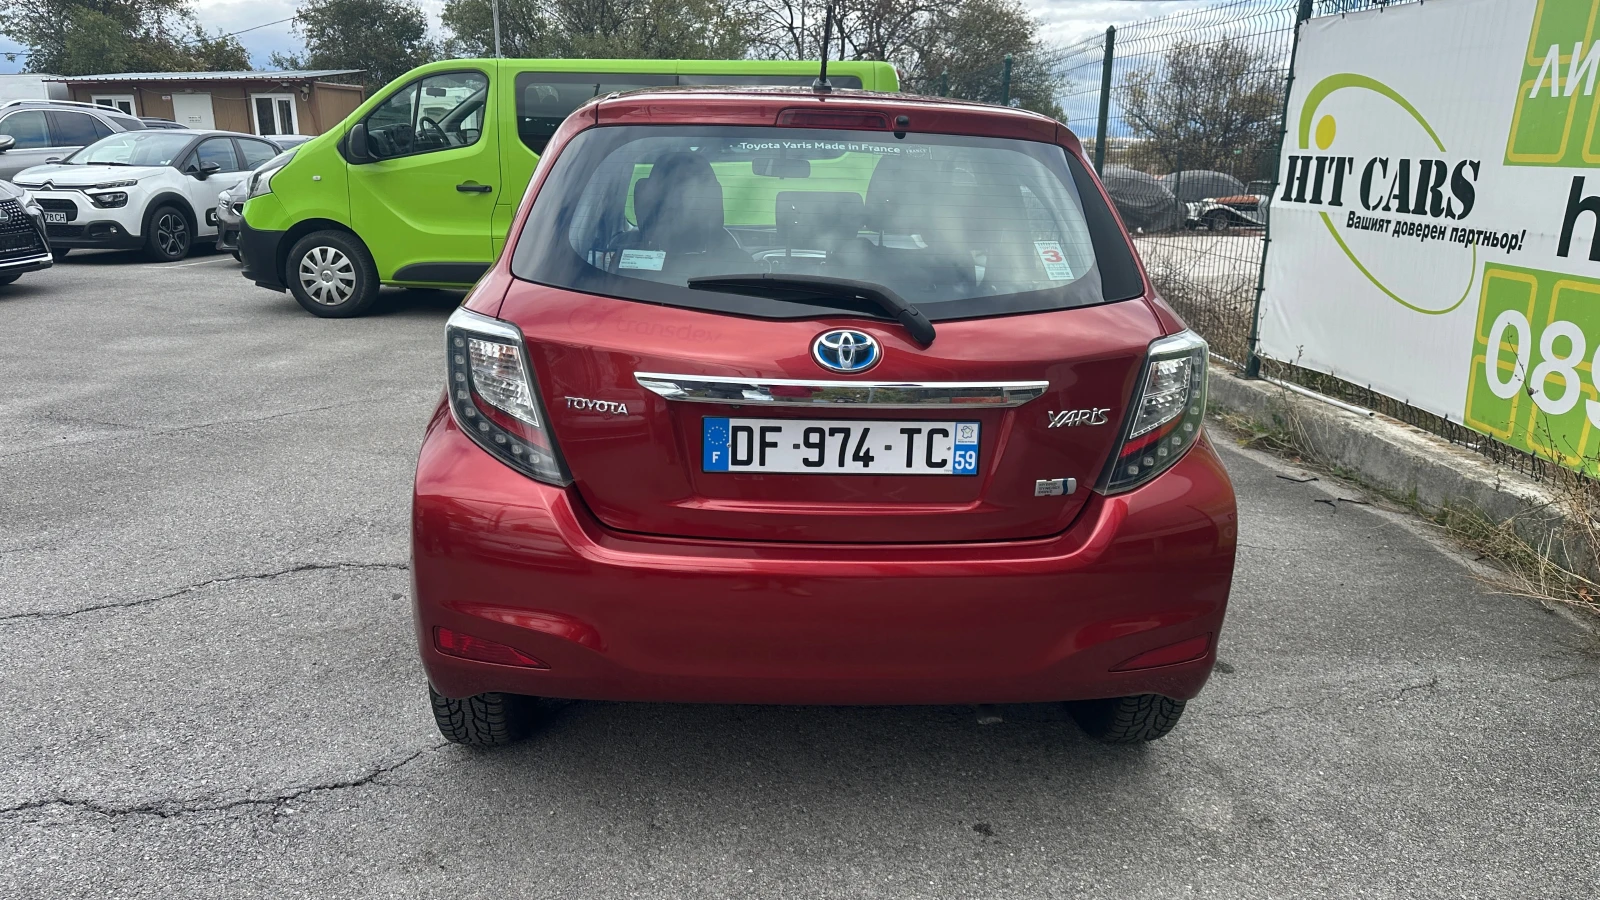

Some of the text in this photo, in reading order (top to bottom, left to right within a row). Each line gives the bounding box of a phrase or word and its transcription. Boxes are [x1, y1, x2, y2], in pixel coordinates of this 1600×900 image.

[740, 142, 780, 150] Toyota
[861, 144, 900, 153] France
[1280, 155, 1481, 220] HIT CARS
[1346, 210, 1527, 254] Вашият доверен партньор!
[1042, 250, 1062, 262] 3
[565, 396, 629, 416] TOYOTA
[712, 451, 720, 463] F
[954, 450, 976, 470] 59
